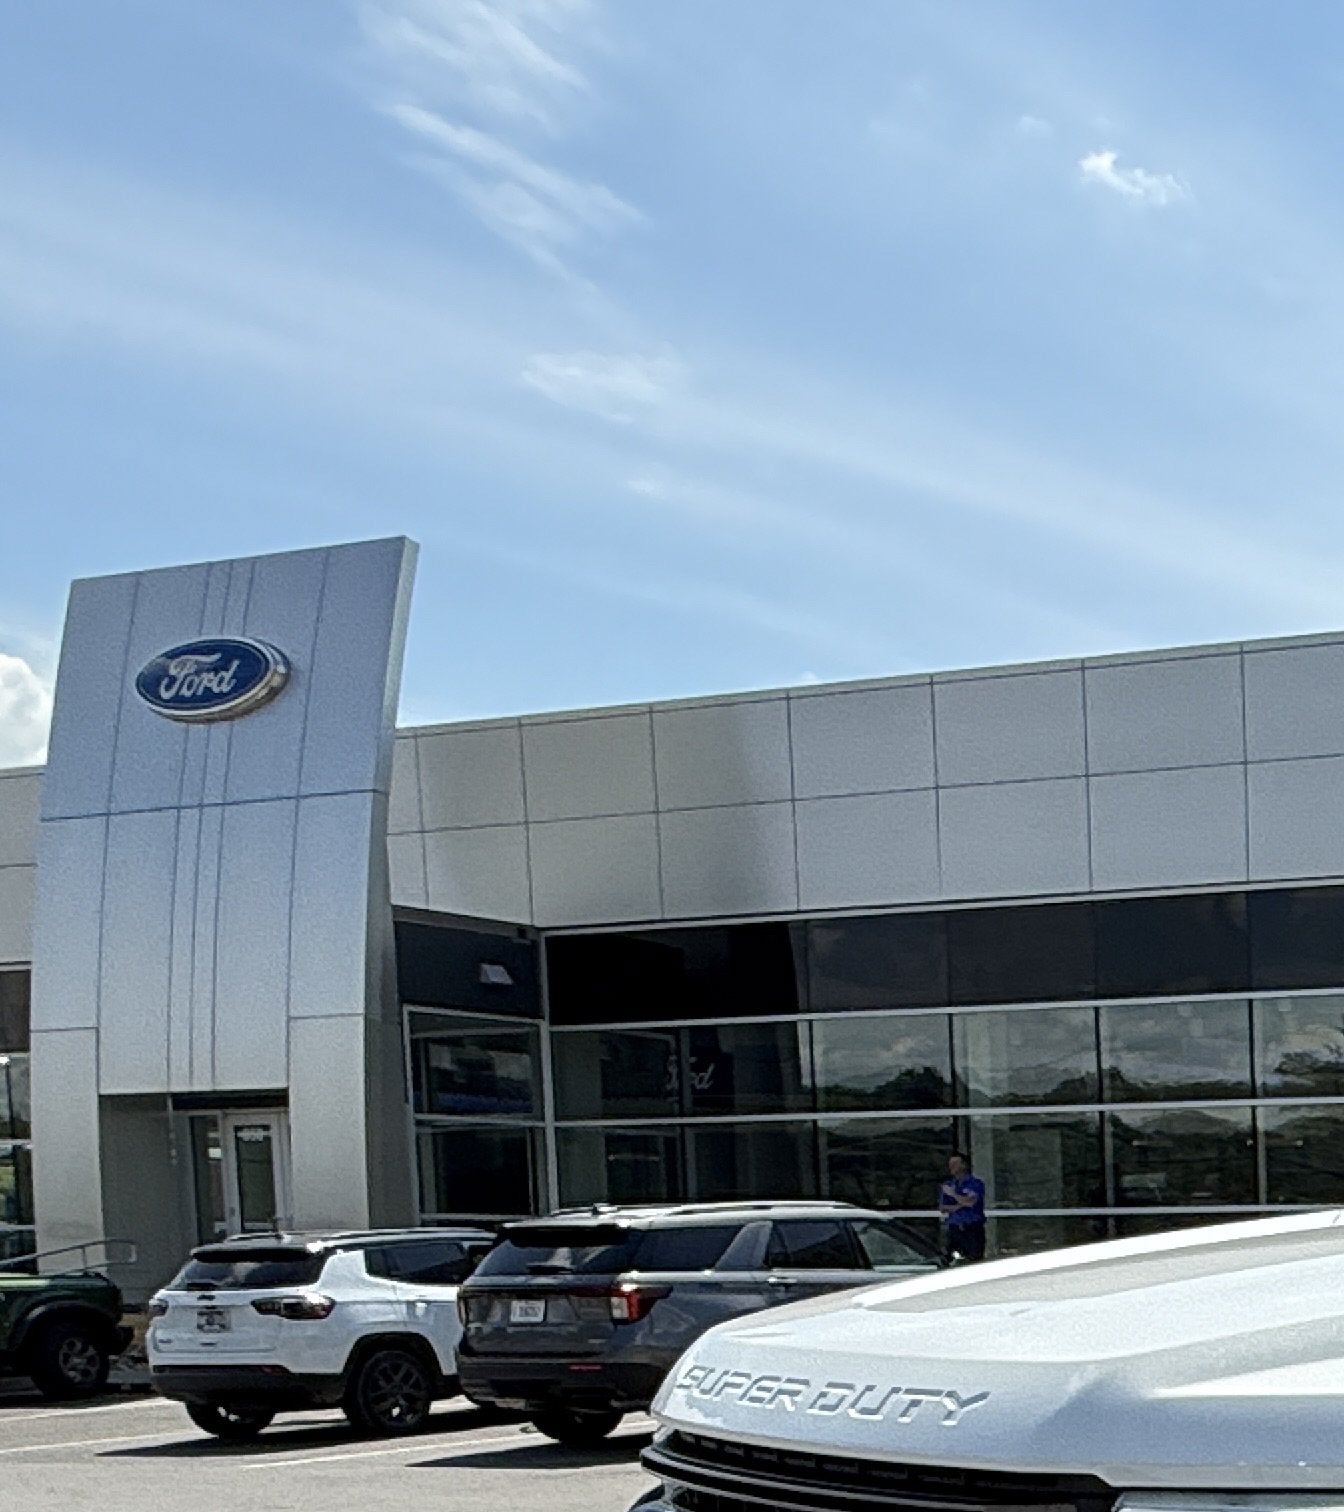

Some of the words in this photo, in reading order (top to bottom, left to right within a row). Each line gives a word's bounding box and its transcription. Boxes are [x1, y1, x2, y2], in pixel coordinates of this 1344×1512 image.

[160, 652, 240, 700] Ford
[676, 1364, 810, 1411] SUPER
[806, 1381, 991, 1426] DUTY
